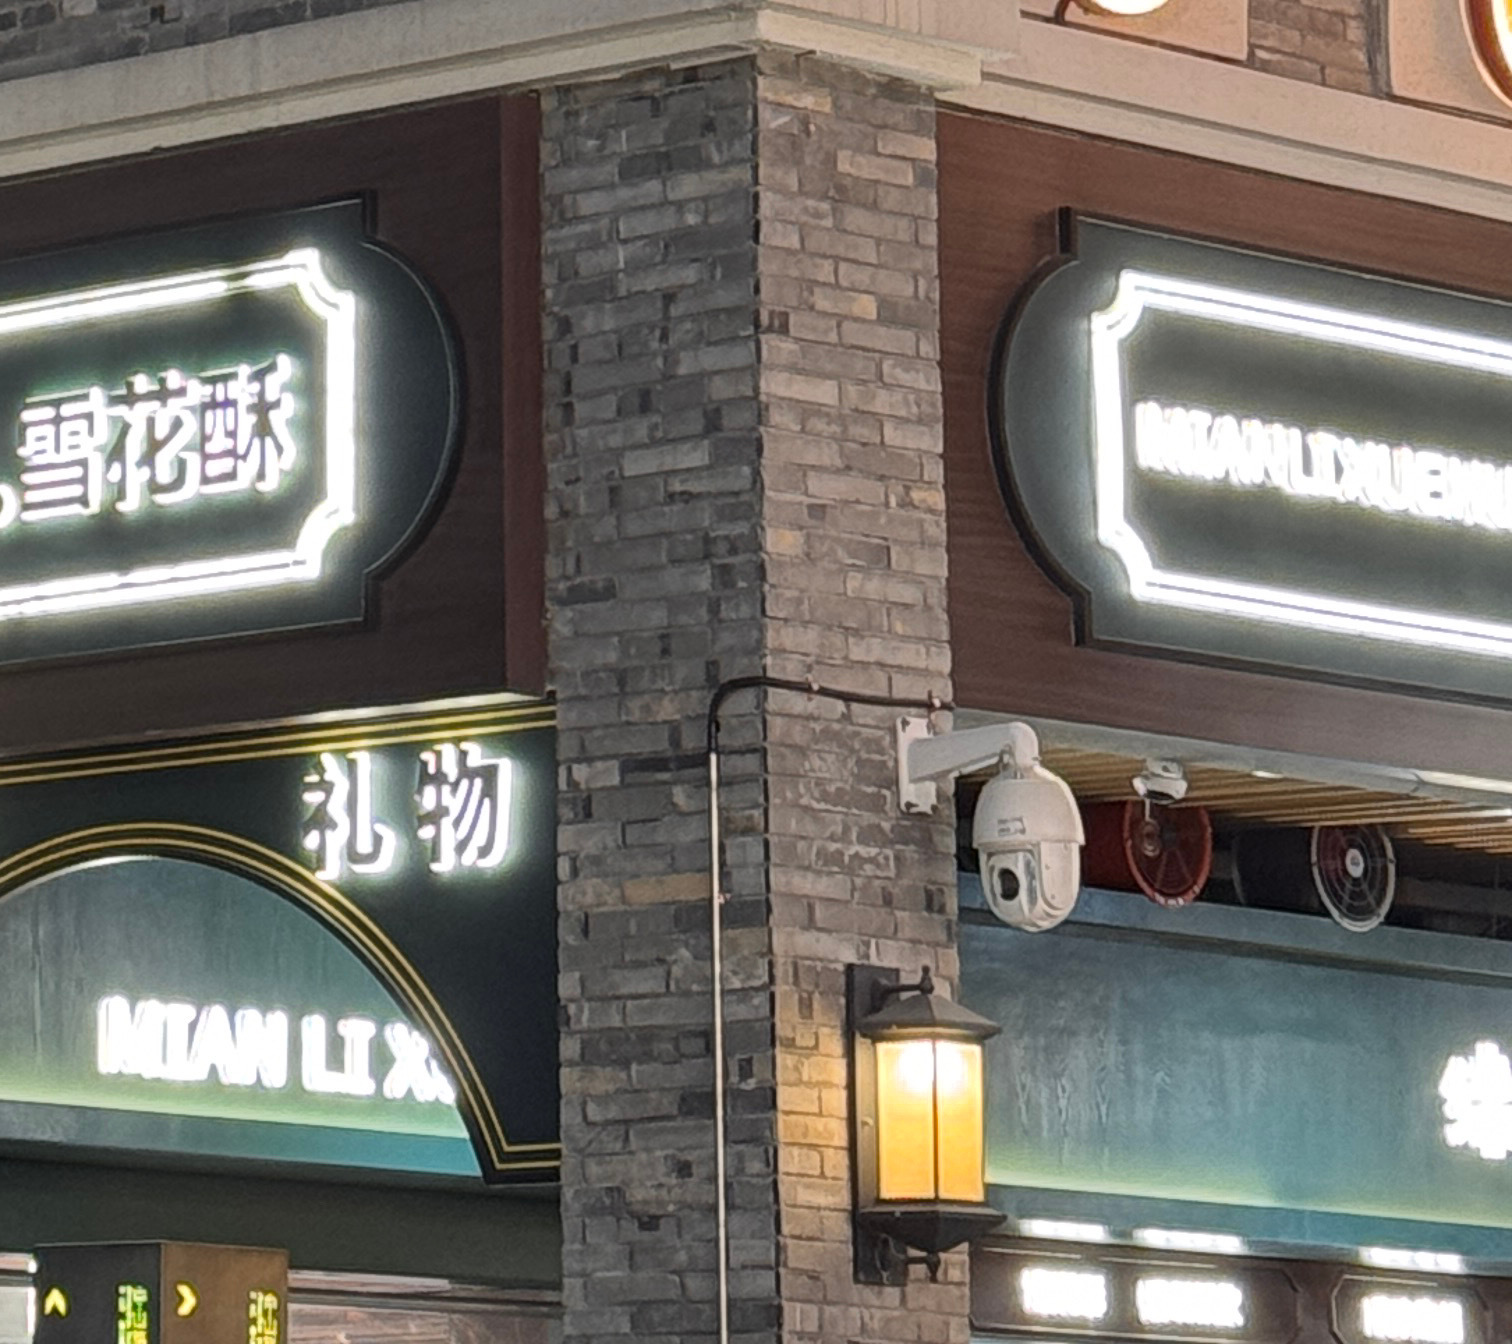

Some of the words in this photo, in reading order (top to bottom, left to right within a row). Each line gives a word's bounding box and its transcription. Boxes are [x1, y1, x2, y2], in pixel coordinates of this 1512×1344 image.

[302, 741, 513, 881] 礼物
[97, 994, 288, 1089] MIAN
[300, 1013, 377, 1097] LI
